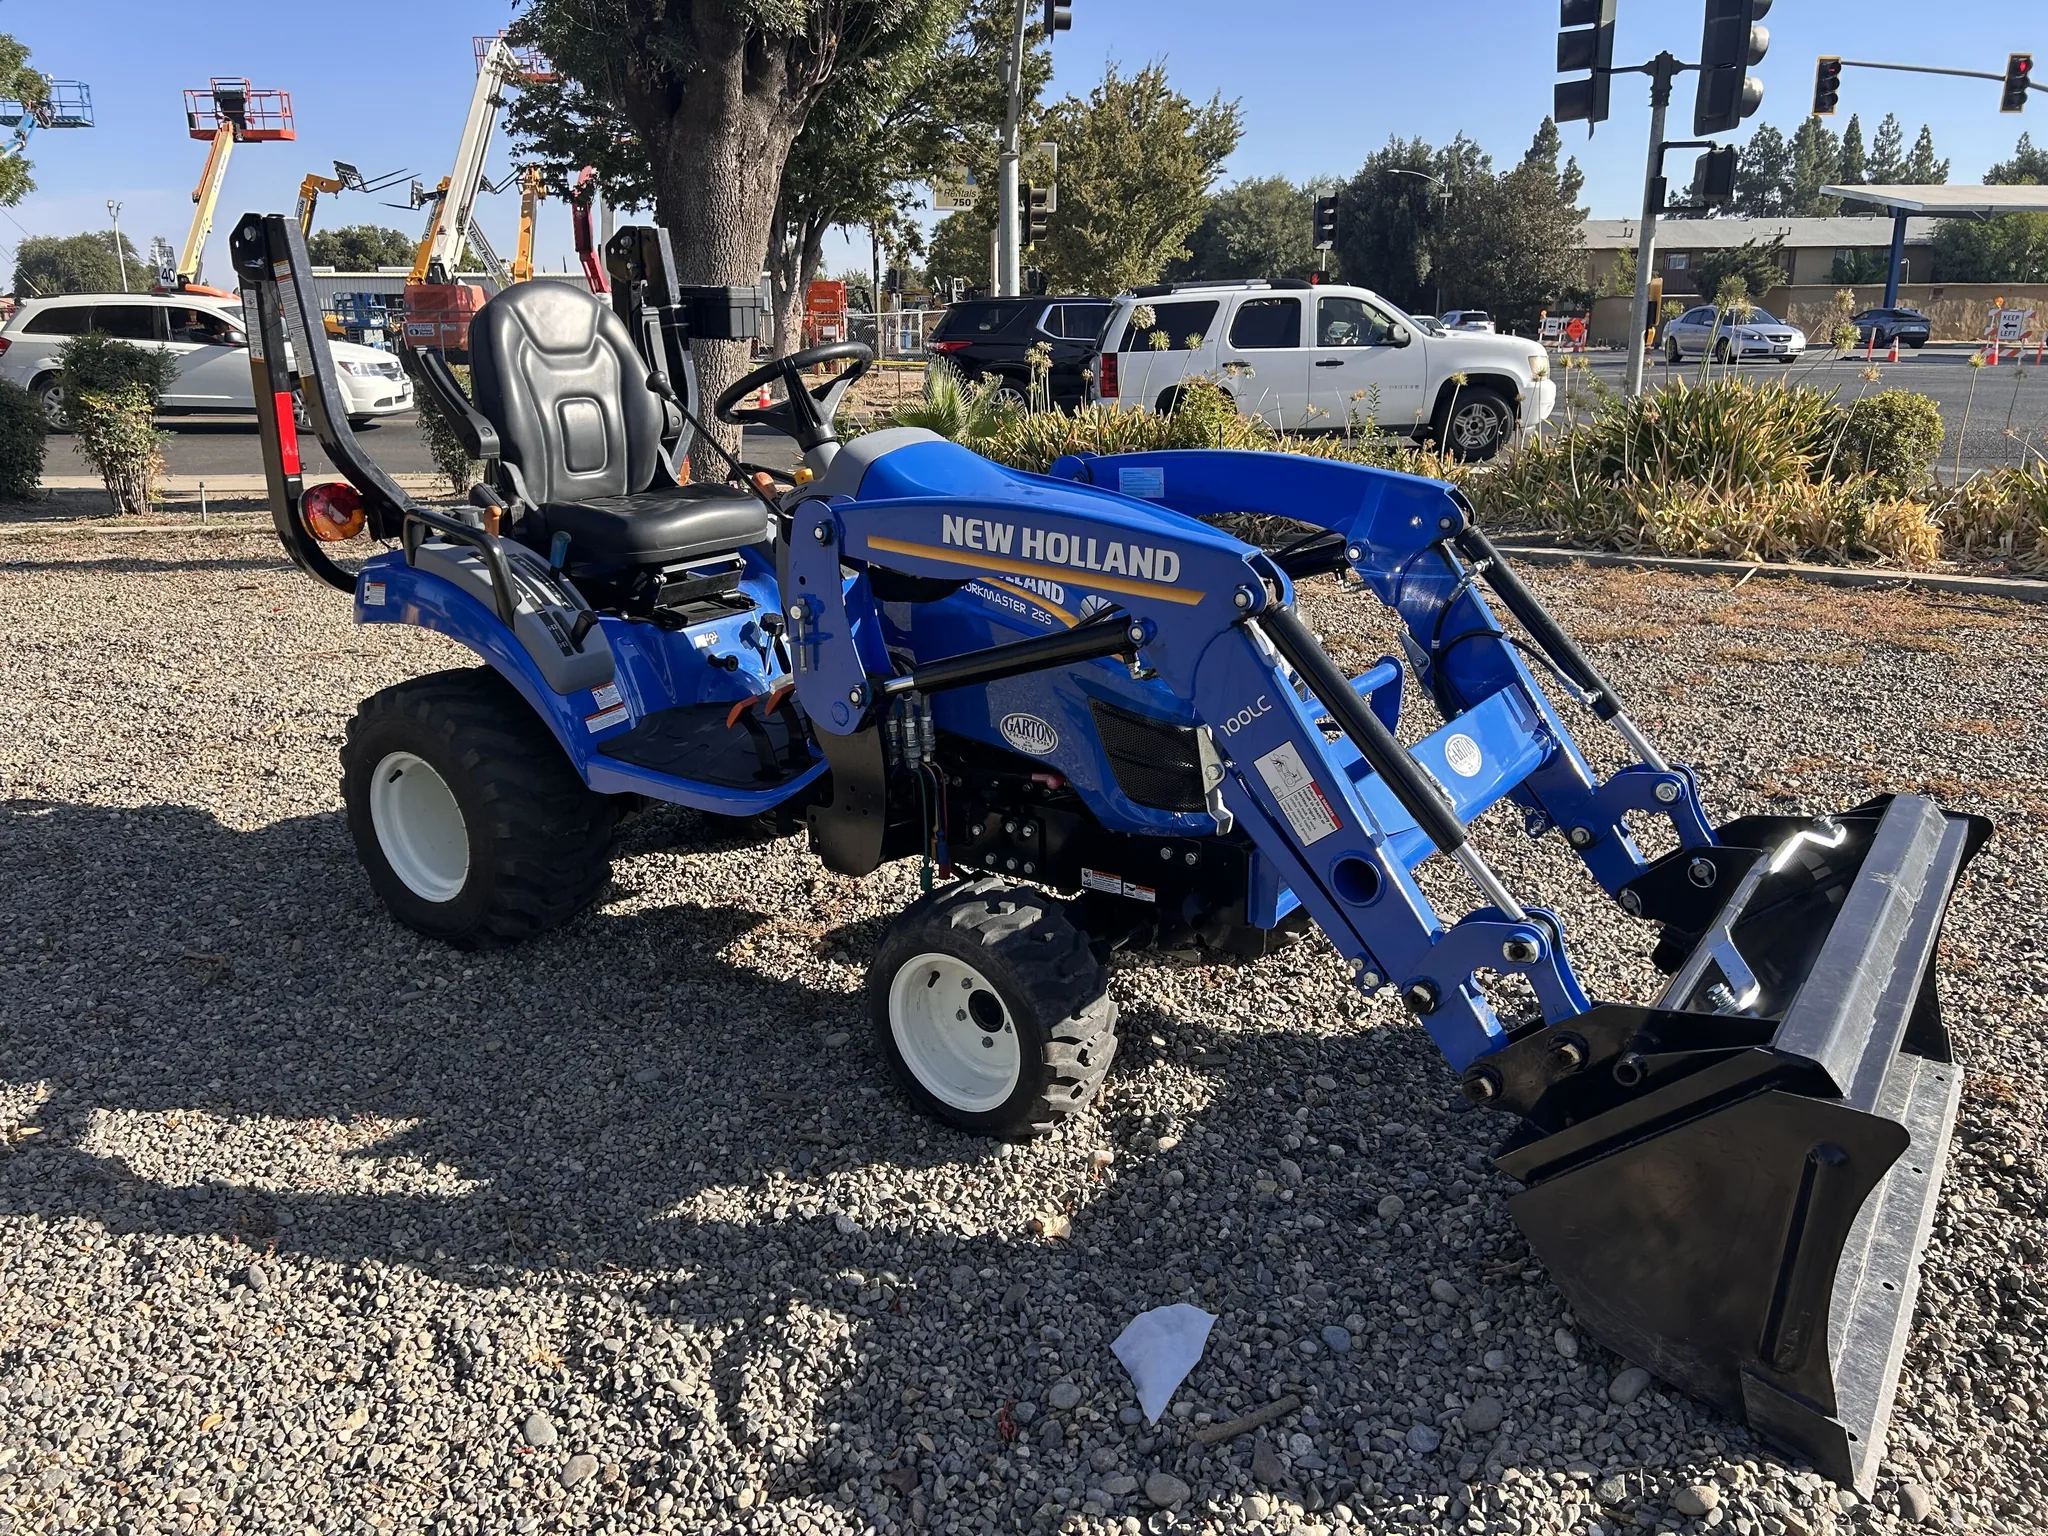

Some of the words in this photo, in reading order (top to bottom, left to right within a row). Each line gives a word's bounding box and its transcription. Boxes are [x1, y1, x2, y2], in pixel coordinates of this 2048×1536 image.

[944, 188, 976, 198] Rentals
[952, 198, 971, 206] 750
[470, 230, 484, 250] United
[482, 249, 497, 273] Rentals
[162, 268, 176, 282] 40
[942, 514, 1014, 554] NEW
[1022, 527, 1180, 583] HOLLAND
[960, 583, 1026, 614] ORKMASTER
[1220, 694, 1272, 737] 100LC
[1004, 717, 1054, 744] GARTON
[1008, 731, 1050, 746] TRACTOR
[1447, 738, 1476, 764] GARTON
[1306, 786, 1318, 801] Failure
[1317, 806, 1330, 824] comply
[1313, 806, 1323, 820] death
[1321, 798, 1335, 818] DANGER
